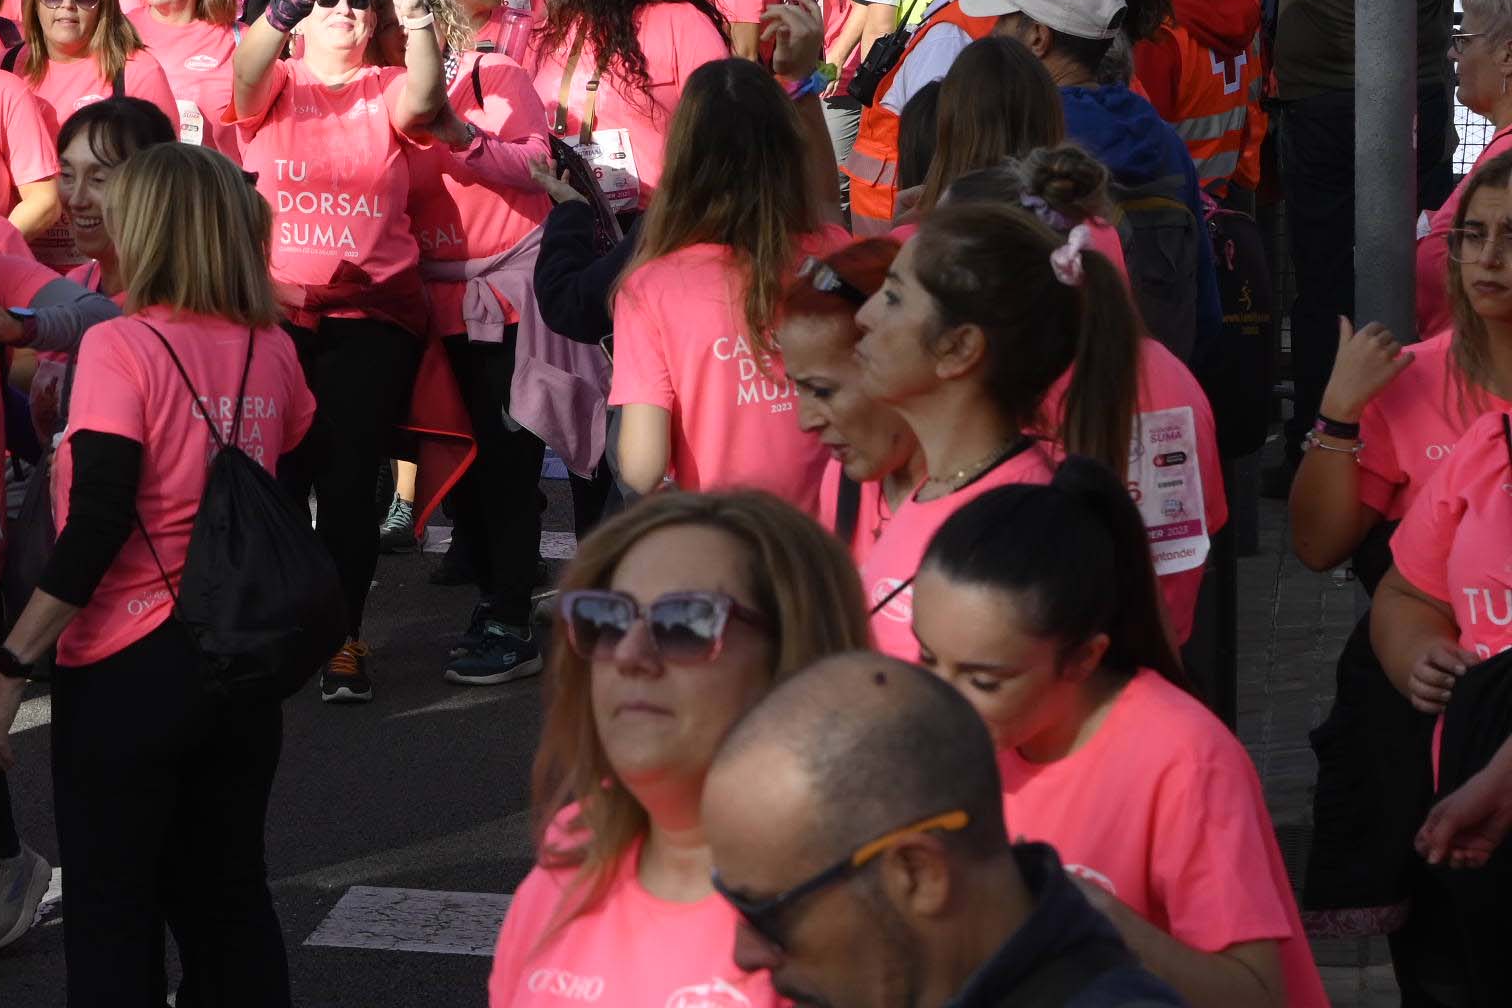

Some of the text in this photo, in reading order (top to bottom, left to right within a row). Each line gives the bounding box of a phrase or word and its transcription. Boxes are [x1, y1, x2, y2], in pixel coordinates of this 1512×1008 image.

[275, 159, 307, 182] TU
[278, 190, 384, 218] DORSAL
[280, 222, 356, 249] SUMA
[770, 401, 793, 414] 2023
[1463, 588, 1512, 626] TU
